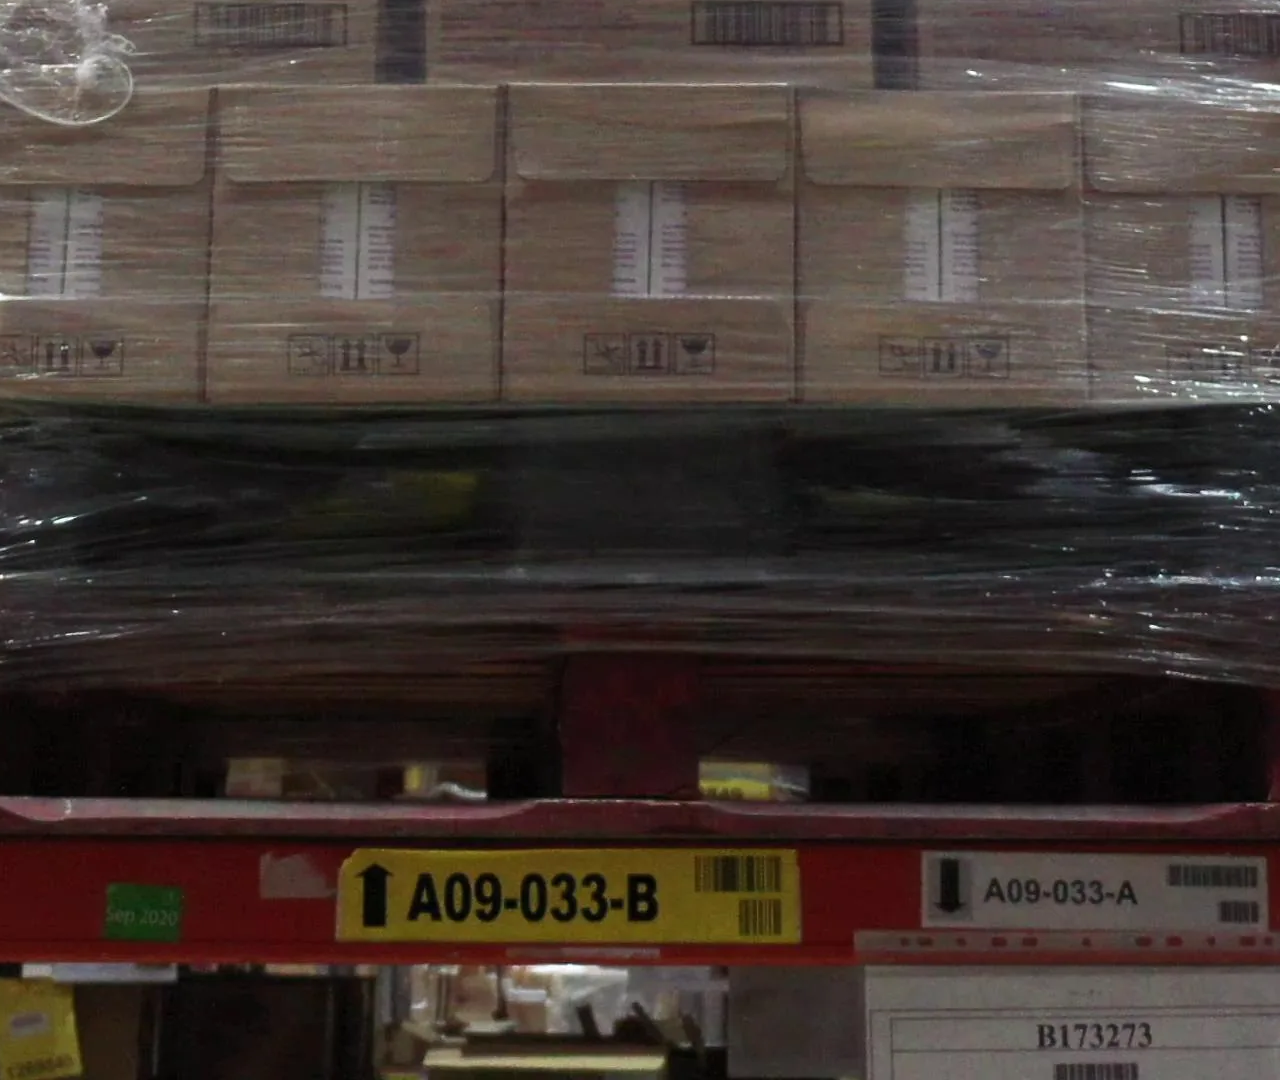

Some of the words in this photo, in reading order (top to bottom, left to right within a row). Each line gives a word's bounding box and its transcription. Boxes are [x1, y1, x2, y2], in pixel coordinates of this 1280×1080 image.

[406, 872, 659, 923] A09-033-B
[983, 877, 1139, 907] A09-033-A
[1036, 1022, 1154, 1051] B173273
